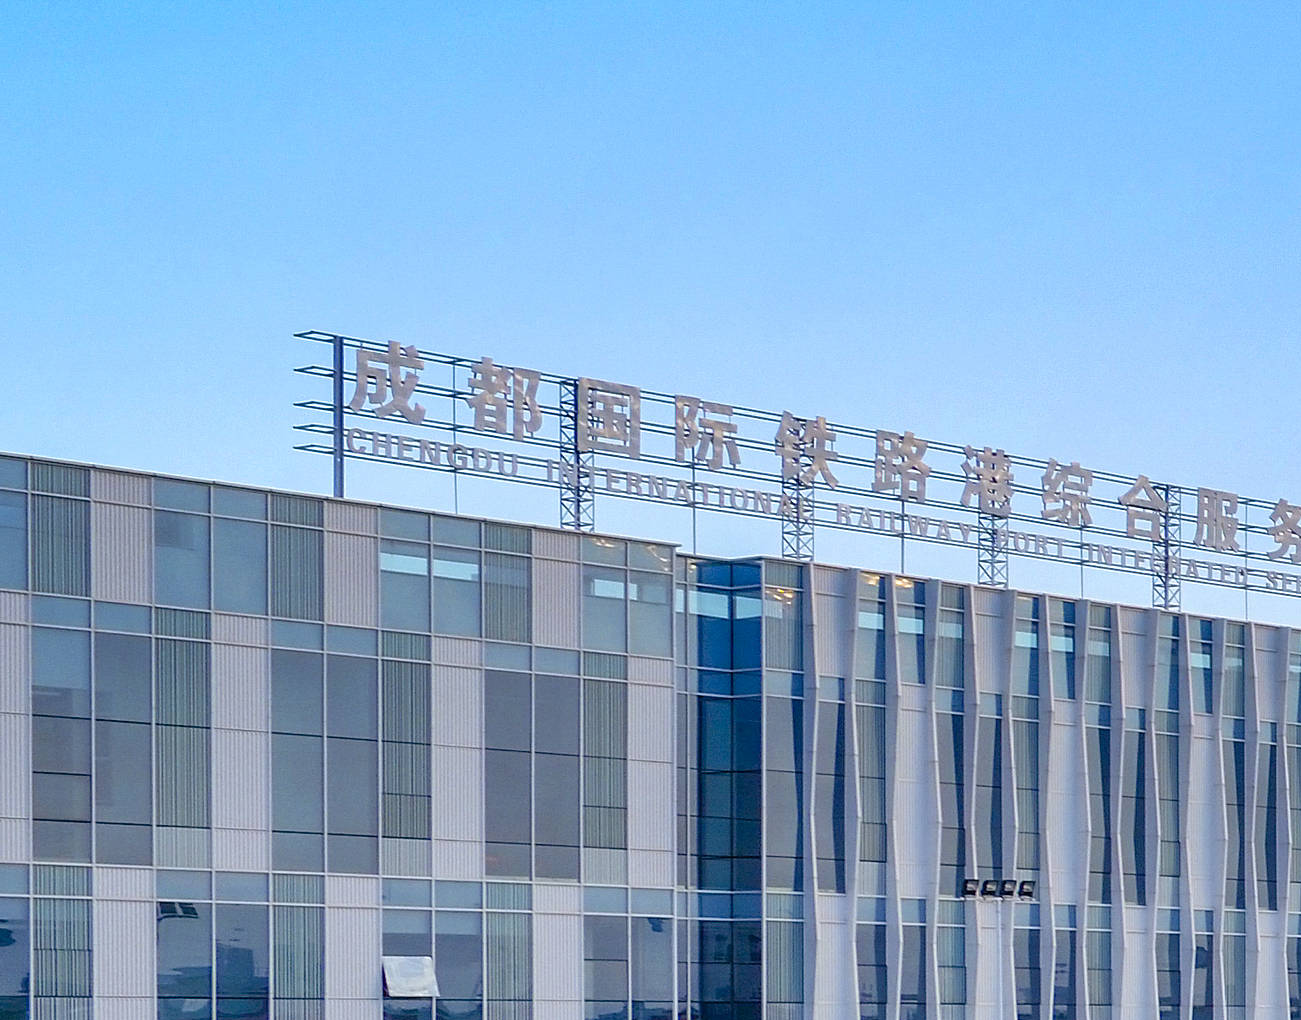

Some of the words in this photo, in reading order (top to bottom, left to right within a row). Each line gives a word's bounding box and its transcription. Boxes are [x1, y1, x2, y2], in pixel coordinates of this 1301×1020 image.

[347, 428, 519, 477] CHENGDU
[547, 458, 812, 520] INTERNATIONAL
[836, 502, 974, 544] RAILWAY
[993, 528, 1066, 558] PORT
[1088, 543, 1249, 586] INTEGRATED
